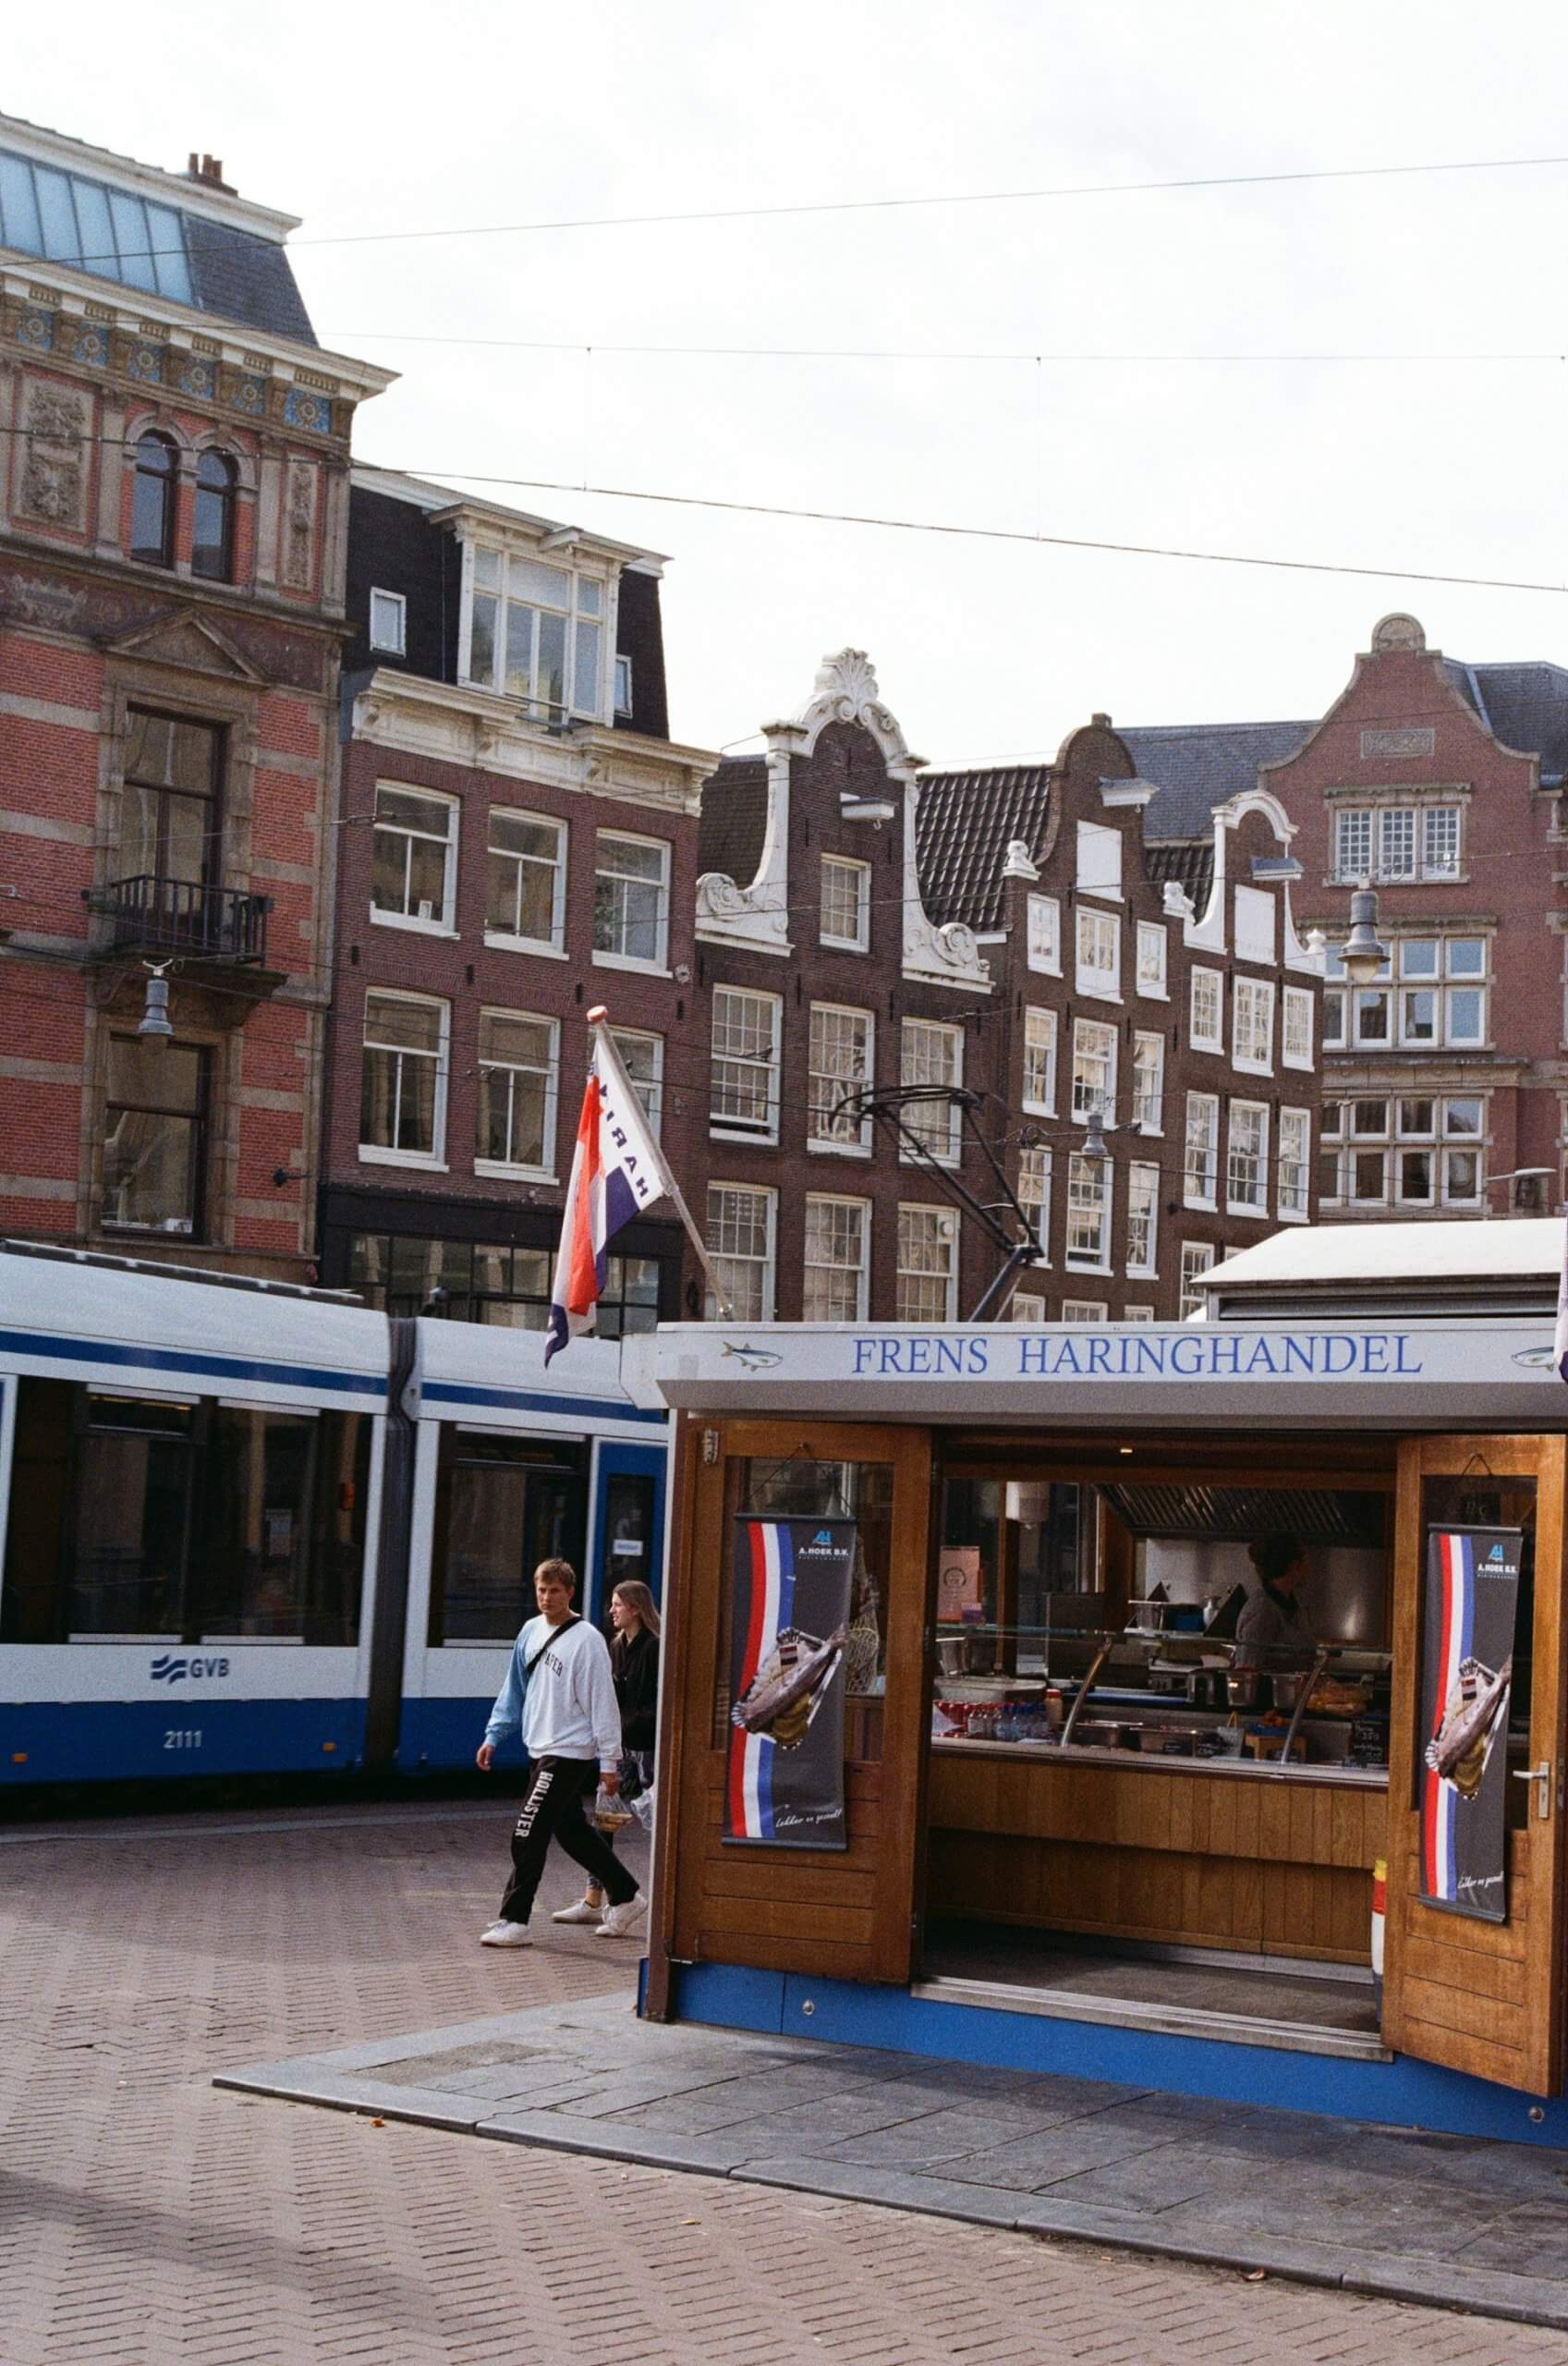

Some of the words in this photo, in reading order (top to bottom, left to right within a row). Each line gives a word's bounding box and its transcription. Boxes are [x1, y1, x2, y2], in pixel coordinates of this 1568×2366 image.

[852, 1337, 989, 1374] FRENS
[1017, 1335, 1423, 1374] HARINGHANDEL
[190, 1658, 230, 1678] GVB
[164, 1730, 203, 1750] 2111
[515, 1771, 554, 1837] HOLLISTER
